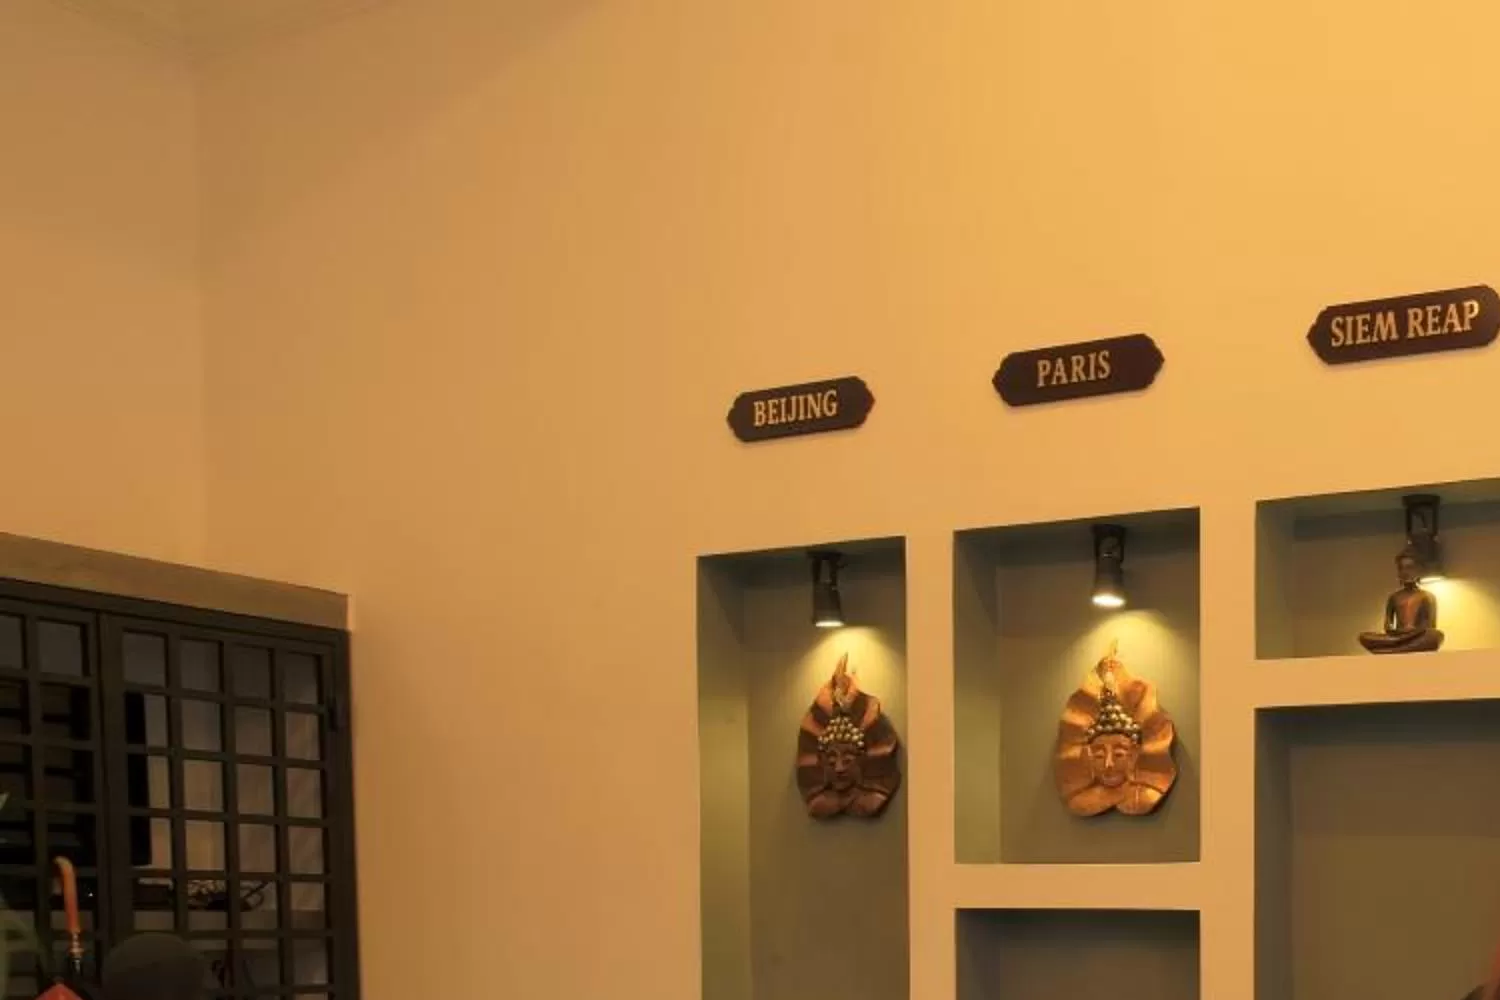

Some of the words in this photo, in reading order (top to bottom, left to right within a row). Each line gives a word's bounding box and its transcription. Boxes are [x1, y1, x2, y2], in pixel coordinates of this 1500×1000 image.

[1330, 312, 1399, 348] SIEM
[1406, 300, 1480, 339] REAP
[1036, 350, 1112, 388] PARIS
[753, 389, 839, 428] BEIJING
